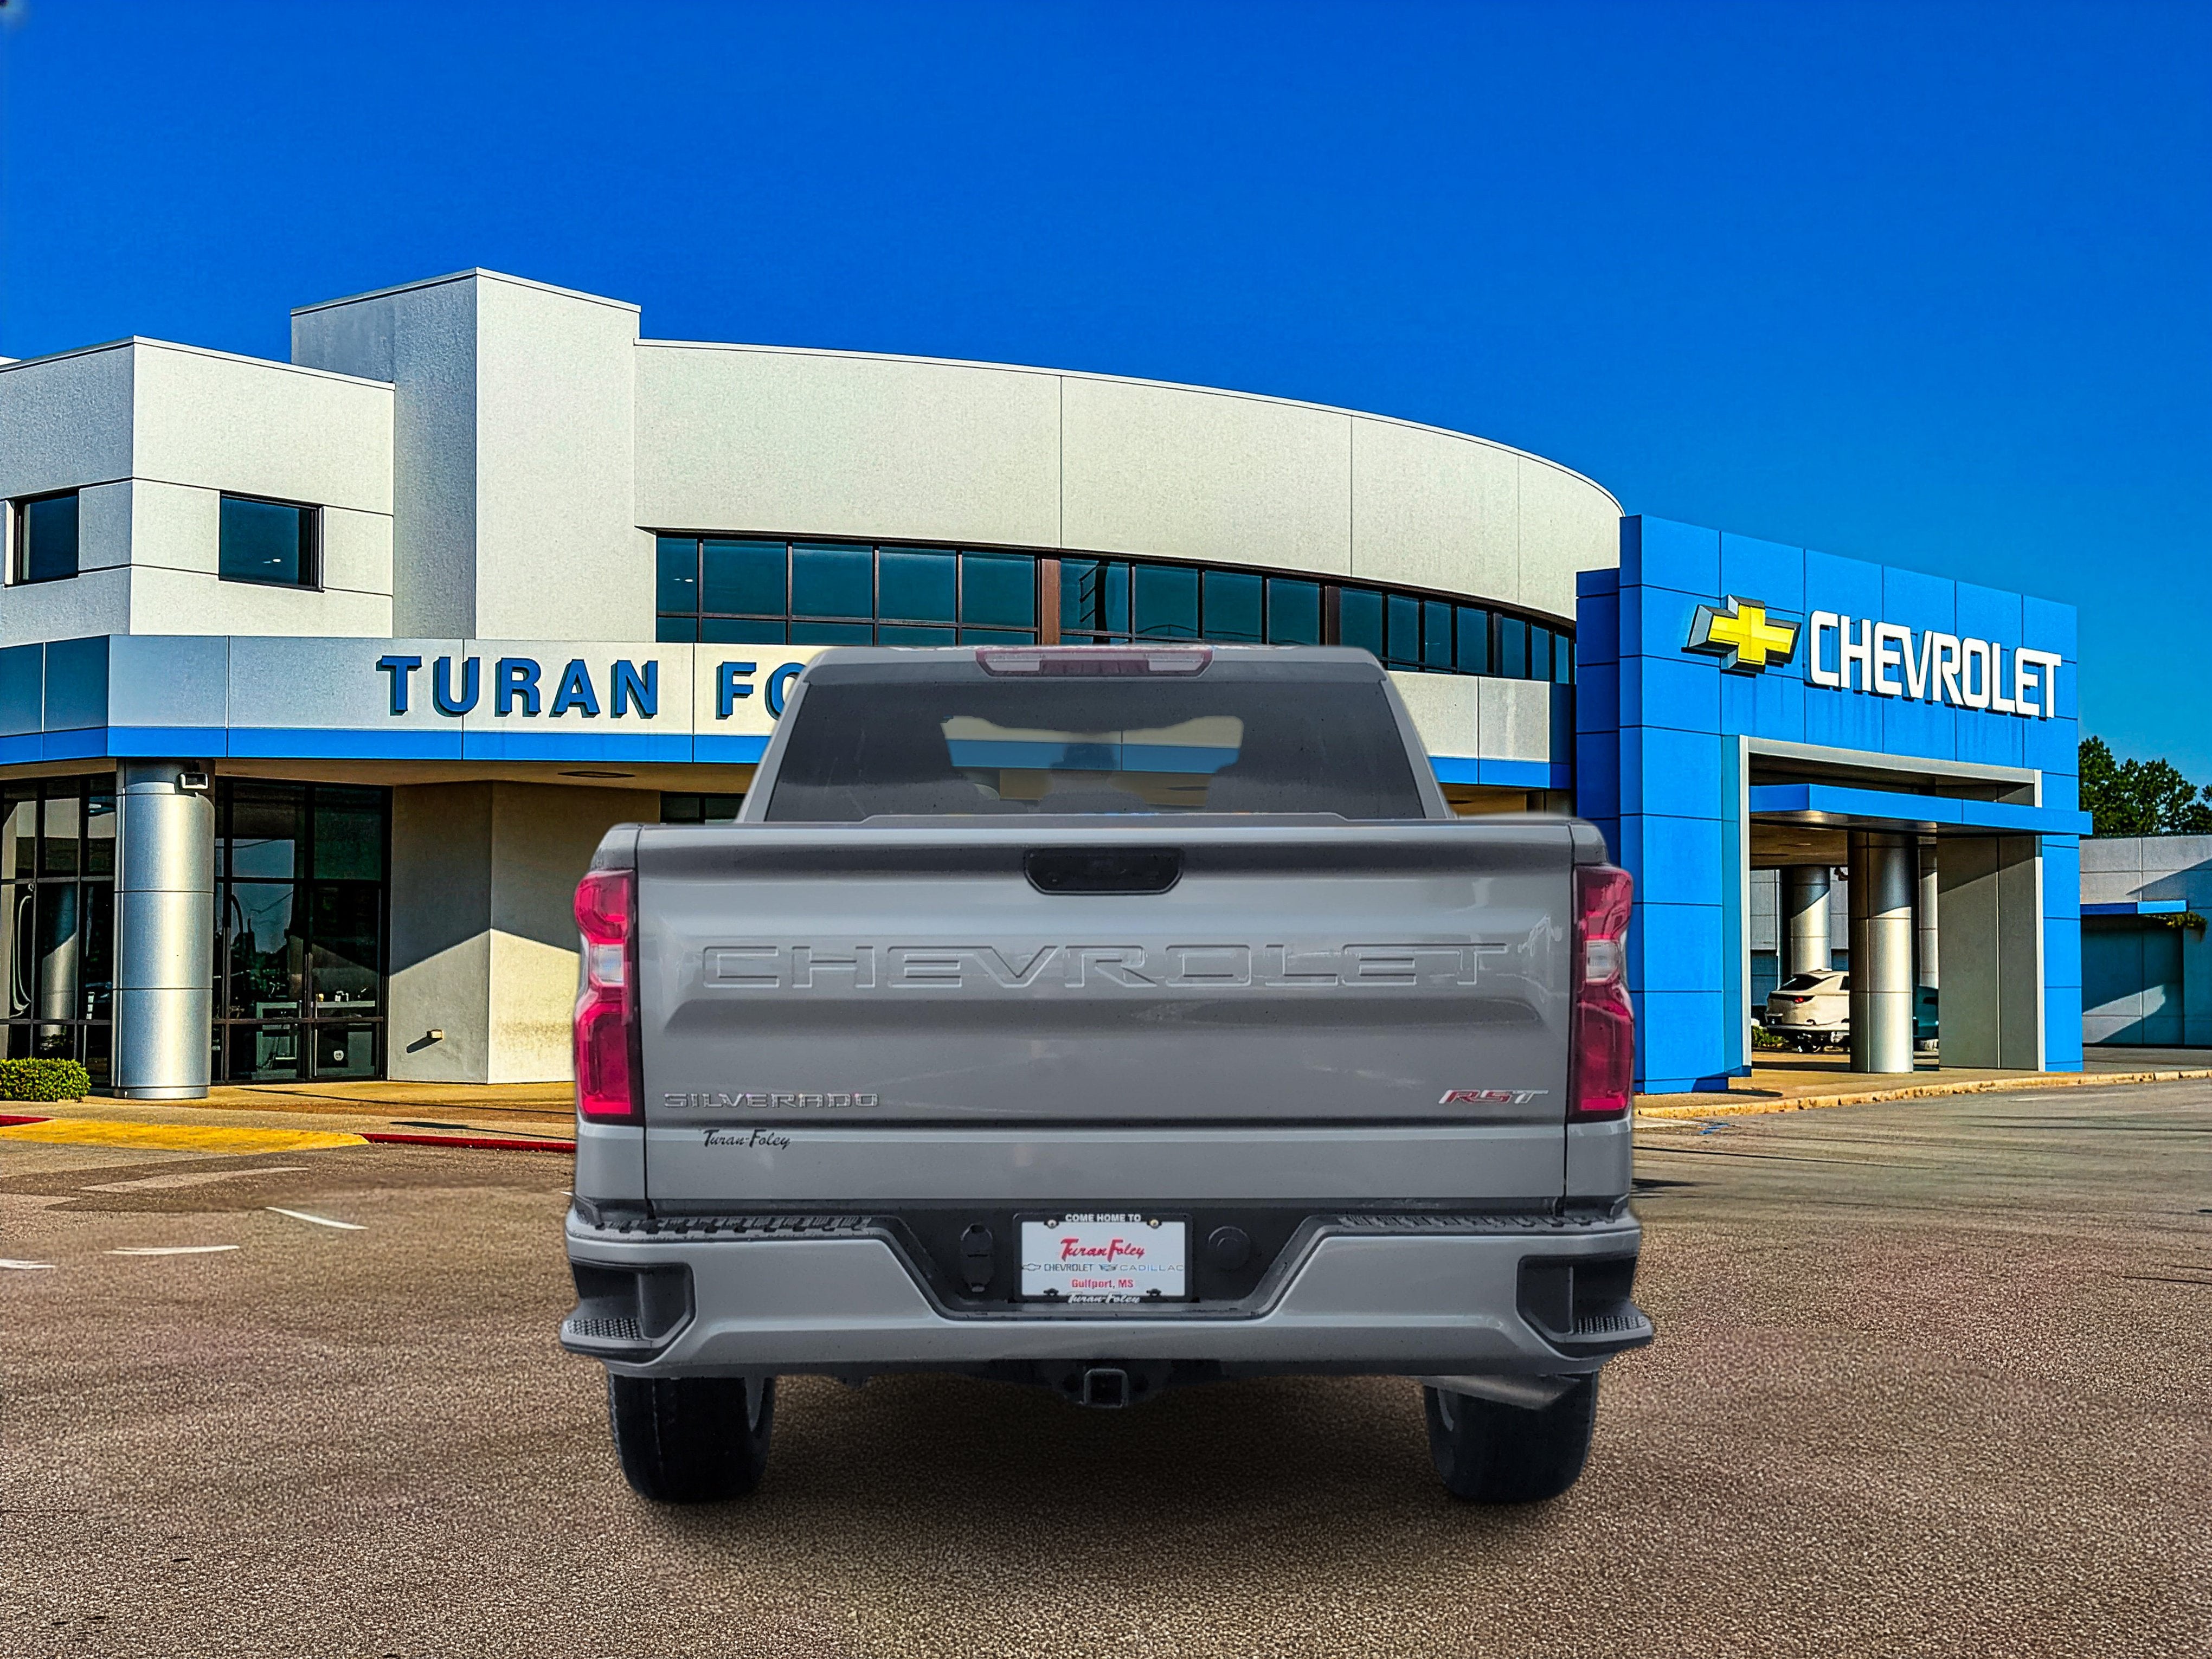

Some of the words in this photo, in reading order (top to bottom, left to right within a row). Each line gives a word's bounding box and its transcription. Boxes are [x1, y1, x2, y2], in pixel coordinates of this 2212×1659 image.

[1808, 609, 2062, 720] CHEVROLET
[376, 655, 658, 719] TURAN
[703, 942, 1509, 988] CHEVROLET
[664, 1092, 879, 1108] SILVERADO
[1438, 1089, 1549, 1104] RST
[1065, 1213, 1095, 1222] COME
[1096, 1213, 1126, 1222] HOME
[1128, 1213, 1141, 1222] TO
[1044, 1263, 1094, 1272] CHEVROLET
[1120, 1264, 1184, 1272] CADILLAC
[1071, 1279, 1116, 1289] Gulfport,
[1118, 1279, 1134, 1288] MS
